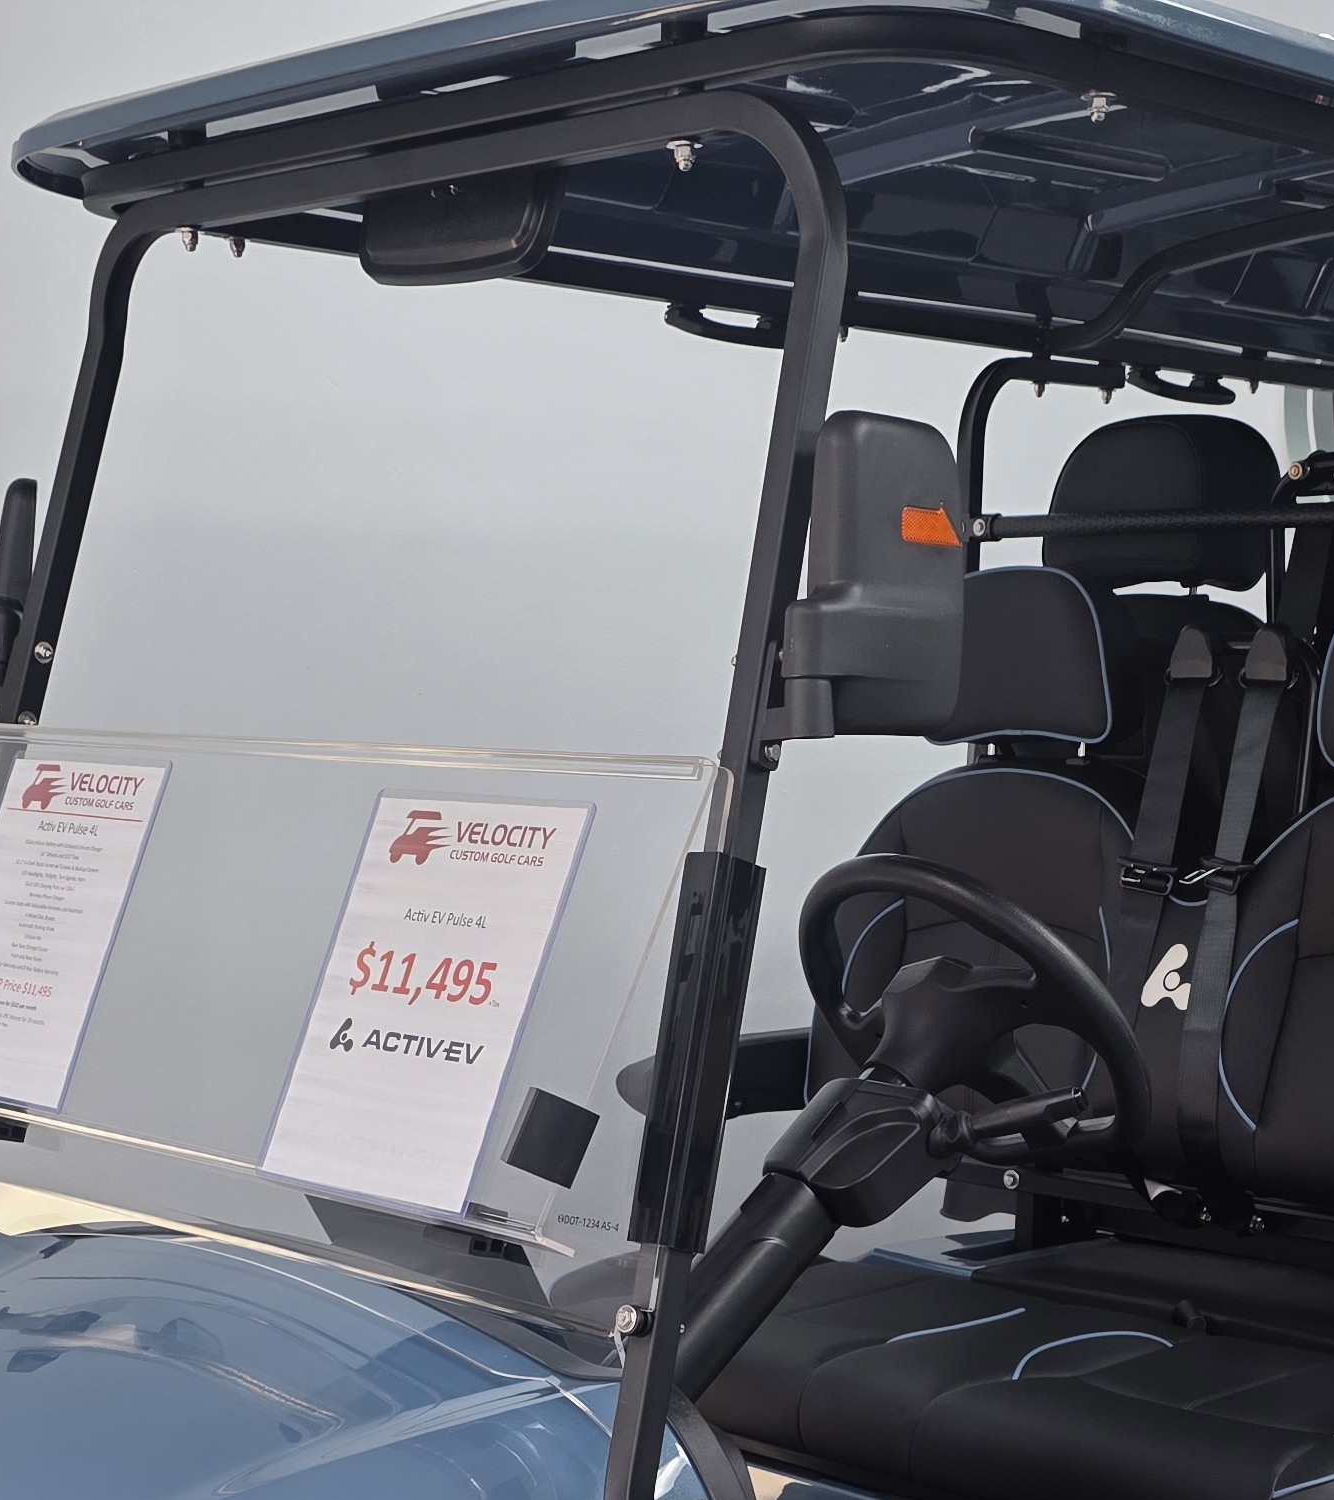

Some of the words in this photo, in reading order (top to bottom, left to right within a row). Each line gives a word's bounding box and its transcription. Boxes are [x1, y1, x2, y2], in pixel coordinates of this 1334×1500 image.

[70, 772, 145, 796] VELOCITY
[64, 796, 94, 807] CUSTOM
[95, 798, 114, 808] GOLF
[115, 800, 135, 811] CARS
[37, 820, 56, 832] Activ
[56, 822, 67, 833] EV
[68, 823, 89, 836] Pulse
[89, 825, 98, 836] 4L
[456, 821, 557, 849] VELOCITY
[449, 849, 489, 863] CUSTOM
[490, 852, 516, 864] GOLF
[517, 855, 545, 867] CARS
[403, 908, 430, 923] Activ
[431, 910, 447, 924] EV
[446, 912, 474, 928] Pulse
[475, 915, 487, 928] 4L
[349, 941, 498, 1006] $11,495
[3, 979, 22, 993] Price
[21, 982, 53, 998] $11,495
[600, 1221, 620, 1232] AS-4
